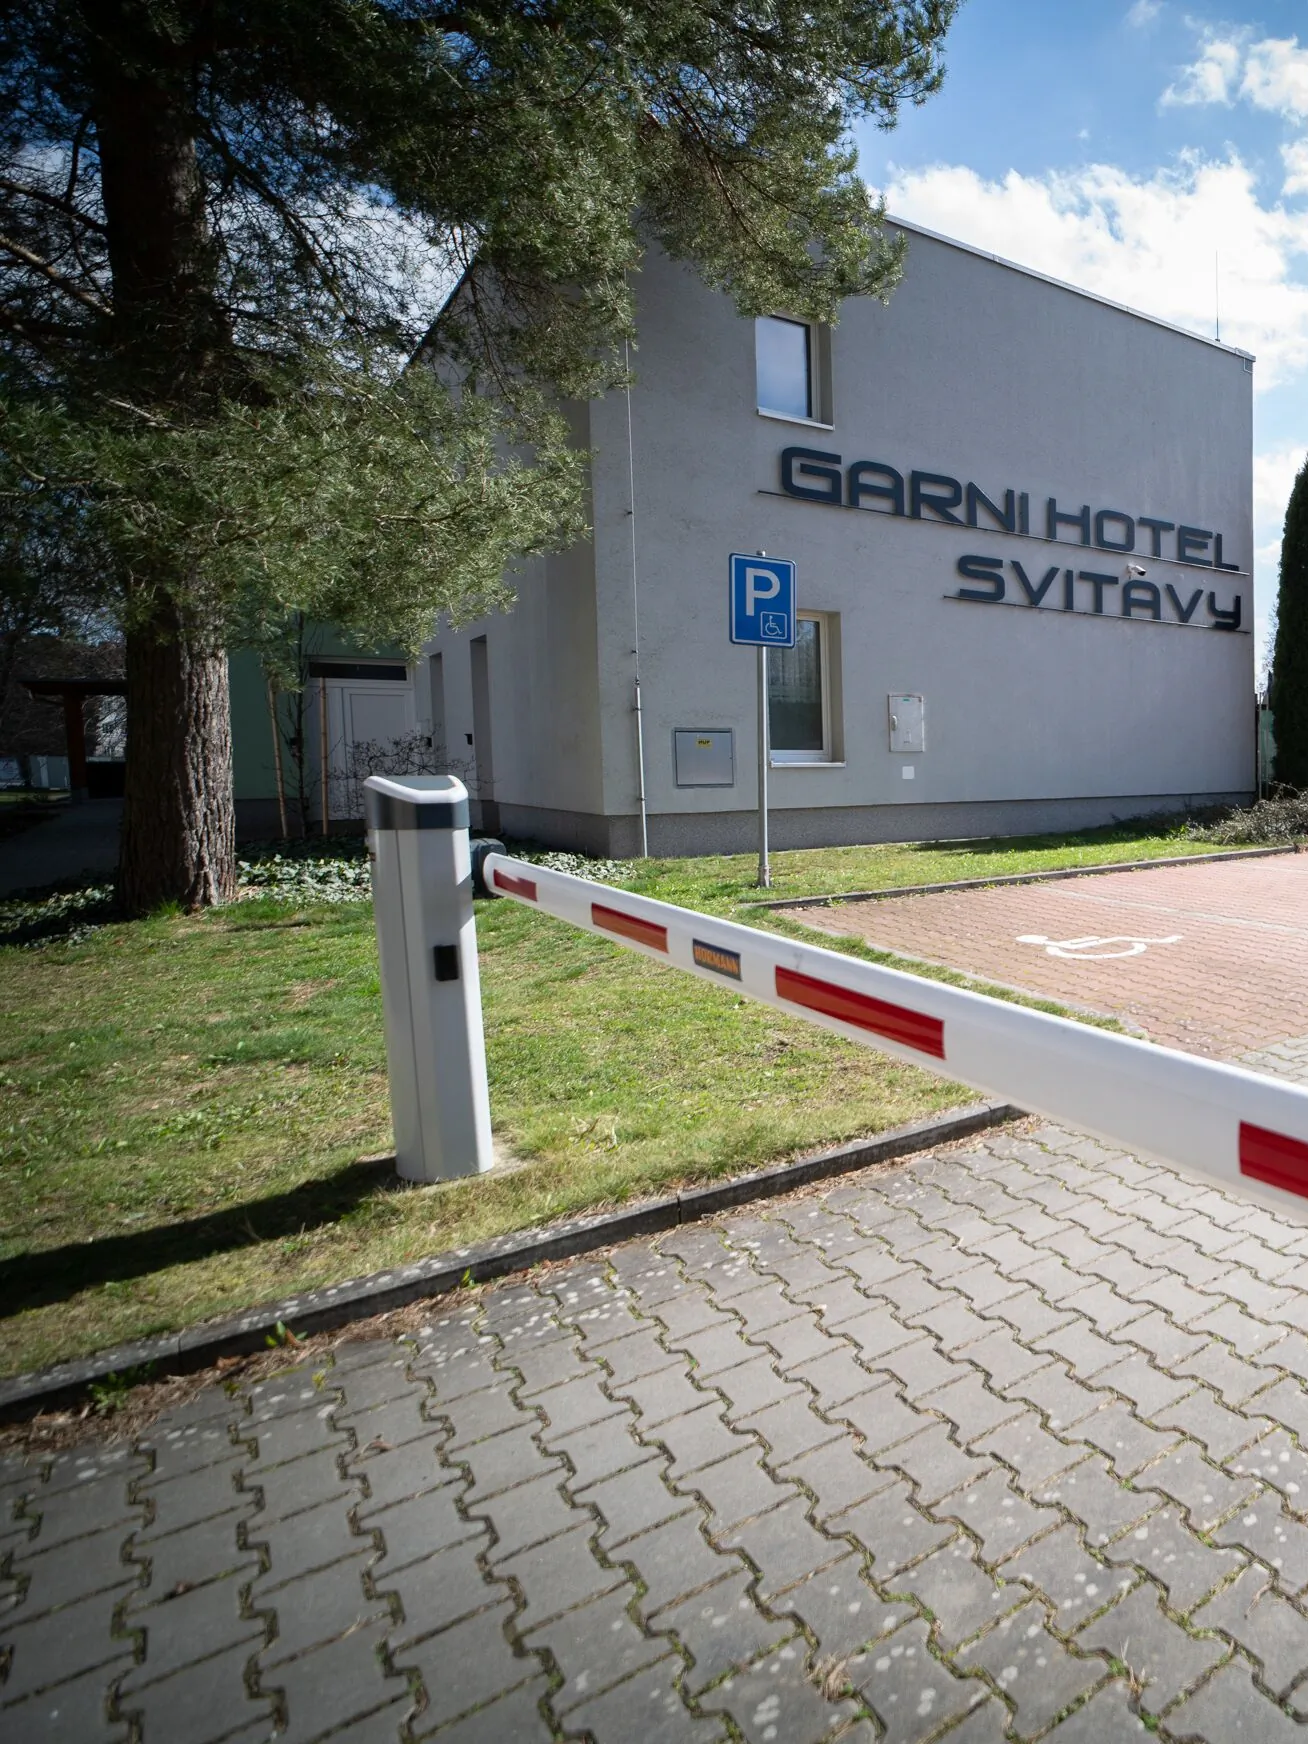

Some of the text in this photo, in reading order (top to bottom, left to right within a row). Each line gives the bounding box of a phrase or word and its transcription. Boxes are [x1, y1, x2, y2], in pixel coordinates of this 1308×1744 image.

[781, 446, 1240, 572] GARNI HOTEL
[745, 567, 781, 617] P
